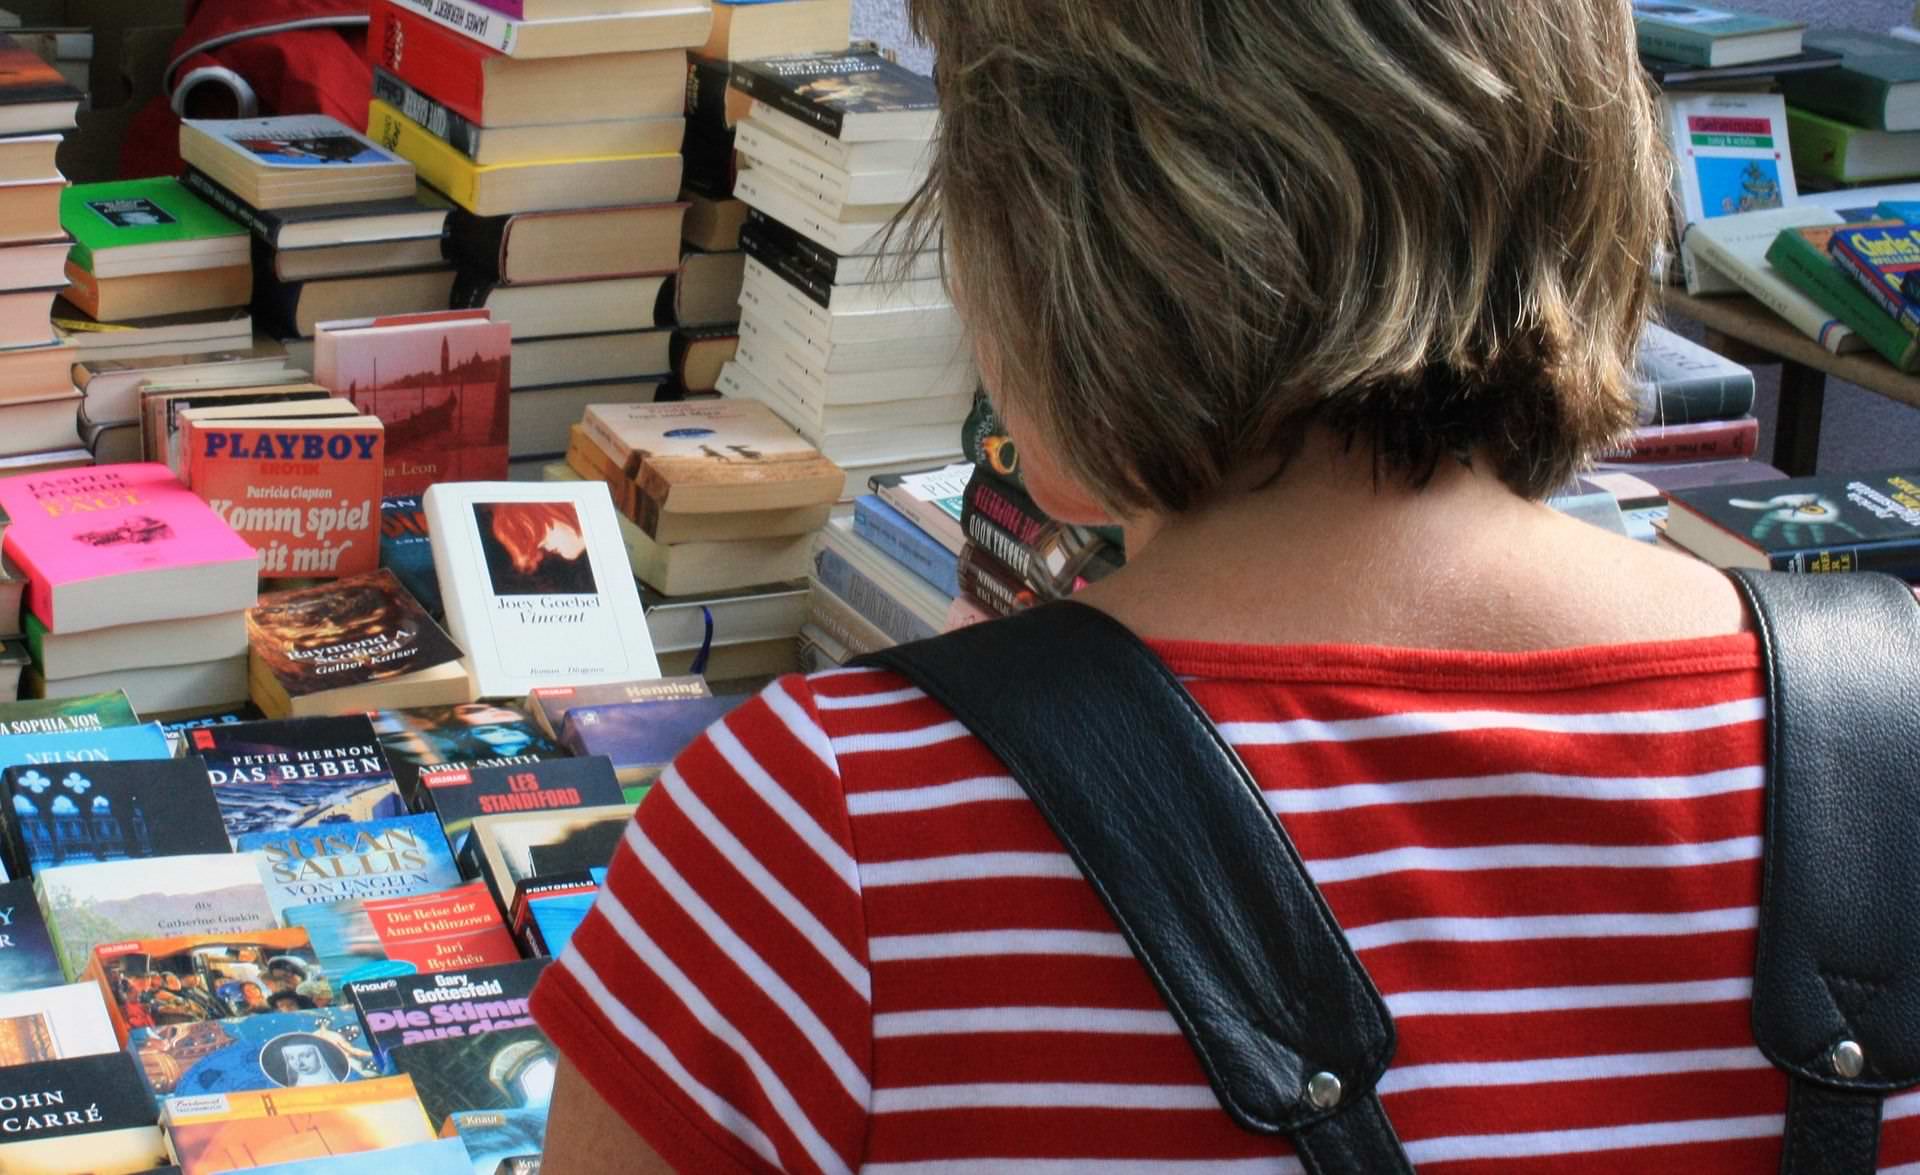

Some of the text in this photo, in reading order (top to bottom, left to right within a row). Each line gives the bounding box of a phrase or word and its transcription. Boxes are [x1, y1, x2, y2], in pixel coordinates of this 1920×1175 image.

[204, 432, 378, 460] PLAYBOY
[402, 461, 437, 475] Leon
[27, 473, 119, 492] JASPER
[247, 486, 333, 501] Patricia Clapton
[306, 498, 371, 540] spiel
[969, 513, 992, 550] WOOD
[291, 540, 353, 571] mir
[497, 596, 600, 613] Joey Goebel
[520, 612, 585, 624] Vincent
[285, 630, 417, 661] Raymond A.
[314, 639, 402, 664] Scofield
[315, 647, 418, 675] Gelber Kaiser
[624, 681, 704, 697] Henning
[11, 717, 66, 735] SOPHIA
[69, 713, 100, 729] VON
[233, 745, 375, 766] PETER HERNON
[476, 754, 541, 769] SMITH
[208, 757, 382, 785] DAS BEBEN
[507, 773, 540, 792] LES
[479, 788, 581, 813] STANDIFORD
[263, 829, 417, 863] SUSAN
[271, 849, 428, 884] SALLIS
[285, 879, 336, 897] VON
[341, 872, 430, 891] ENGELN
[526, 880, 595, 894] PORTOBELLO
[158, 912, 259, 929] Catherine Gaskin
[387, 901, 478, 924] Die Reise der
[386, 913, 493, 938] Anna Odinzowa
[434, 941, 464, 956] Juri
[412, 980, 503, 1004] Gottesfeld
[434, 974, 468, 988] Gary
[367, 1009, 430, 1033] Die
[2, 1103, 102, 1133] CARRÉ
